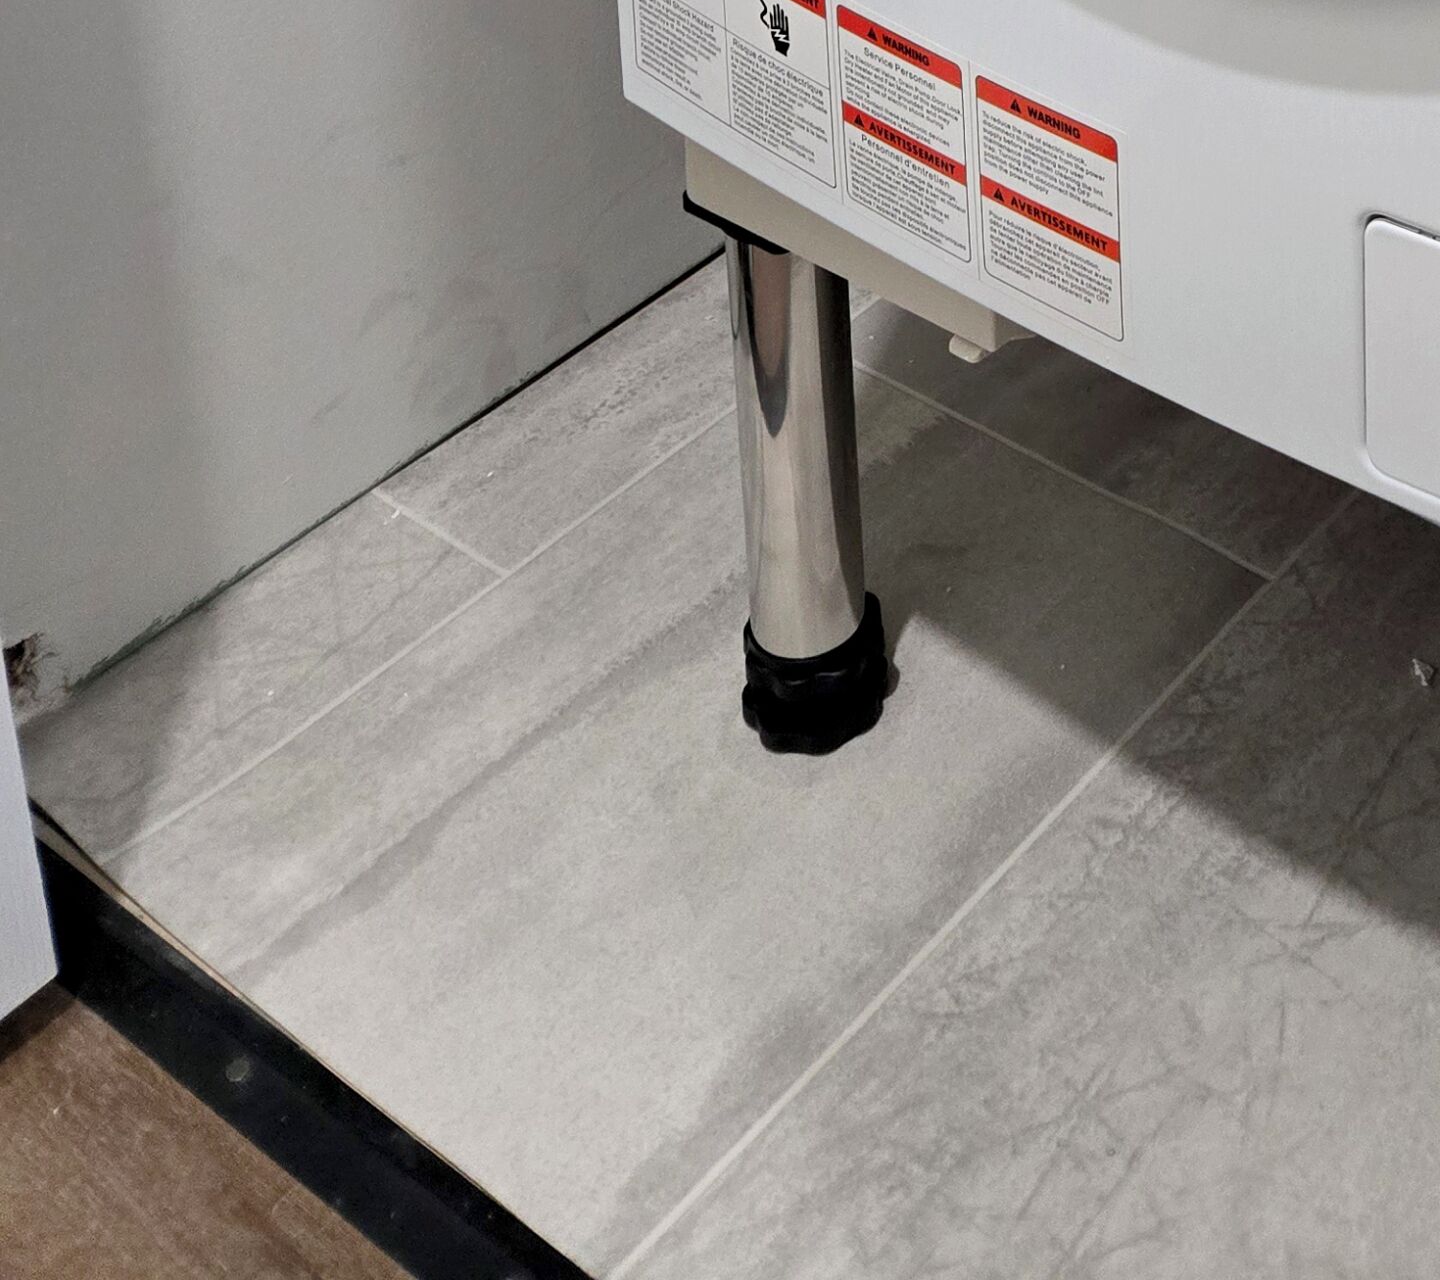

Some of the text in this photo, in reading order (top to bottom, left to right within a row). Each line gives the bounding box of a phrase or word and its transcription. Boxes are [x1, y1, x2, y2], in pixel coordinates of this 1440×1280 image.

[672, 0, 690, 18] Shock
[691, 12, 713, 32] Hazard
[732, 37, 756, 60] Risque
[757, 51, 766, 65] de
[767, 57, 785, 76] choc
[864, 47, 936, 91] Service Personnel
[882, 34, 930, 66] WARNING
[1027, 106, 1080, 138] WARNING
[861, 133, 949, 189] Personnel d'entretien
[868, 120, 955, 176] AVERTISSEMENT
[1010, 194, 1107, 253] AVERTISSEMENT
